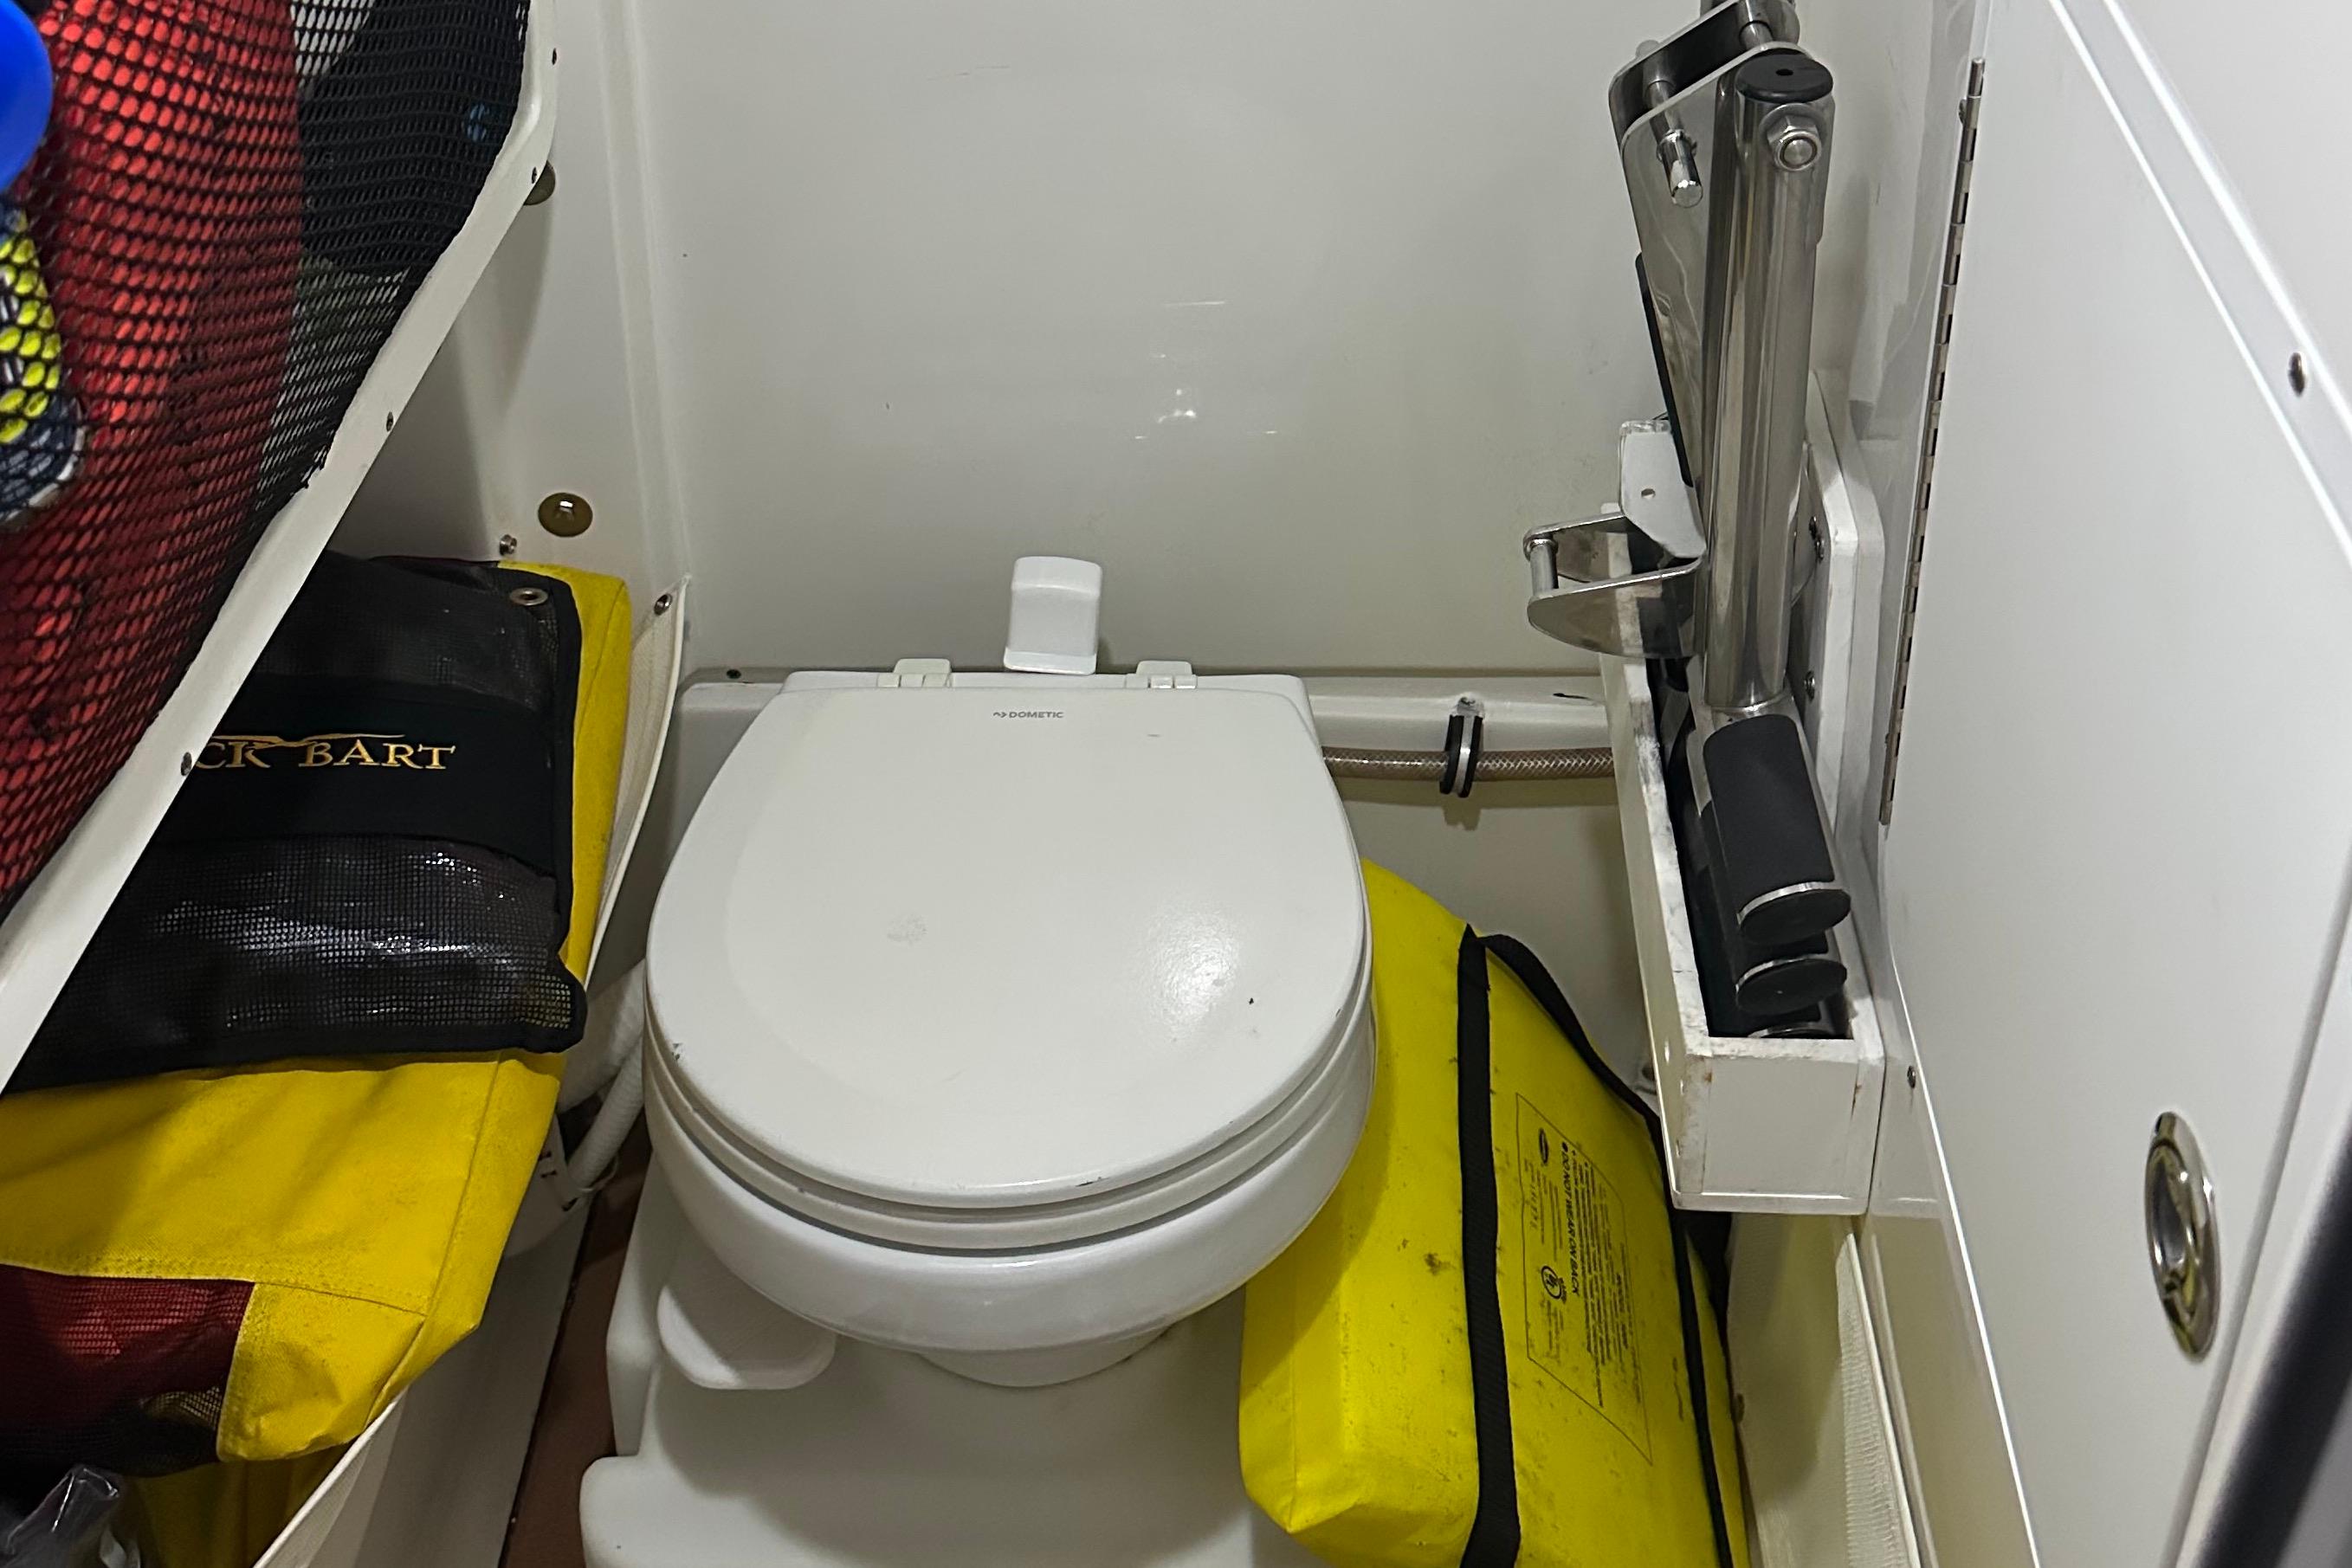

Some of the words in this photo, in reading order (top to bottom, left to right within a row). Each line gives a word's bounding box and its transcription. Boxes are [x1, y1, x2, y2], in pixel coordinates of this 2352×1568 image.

[299, 739, 456, 770] BART
[1562, 1152, 1570, 1171] DO
[1563, 1171, 1572, 1198] NOT
[1566, 1199, 1576, 1237] WEAR
[1568, 1237, 1577, 1257] ON
[1570, 1258, 1580, 1297] BACK
